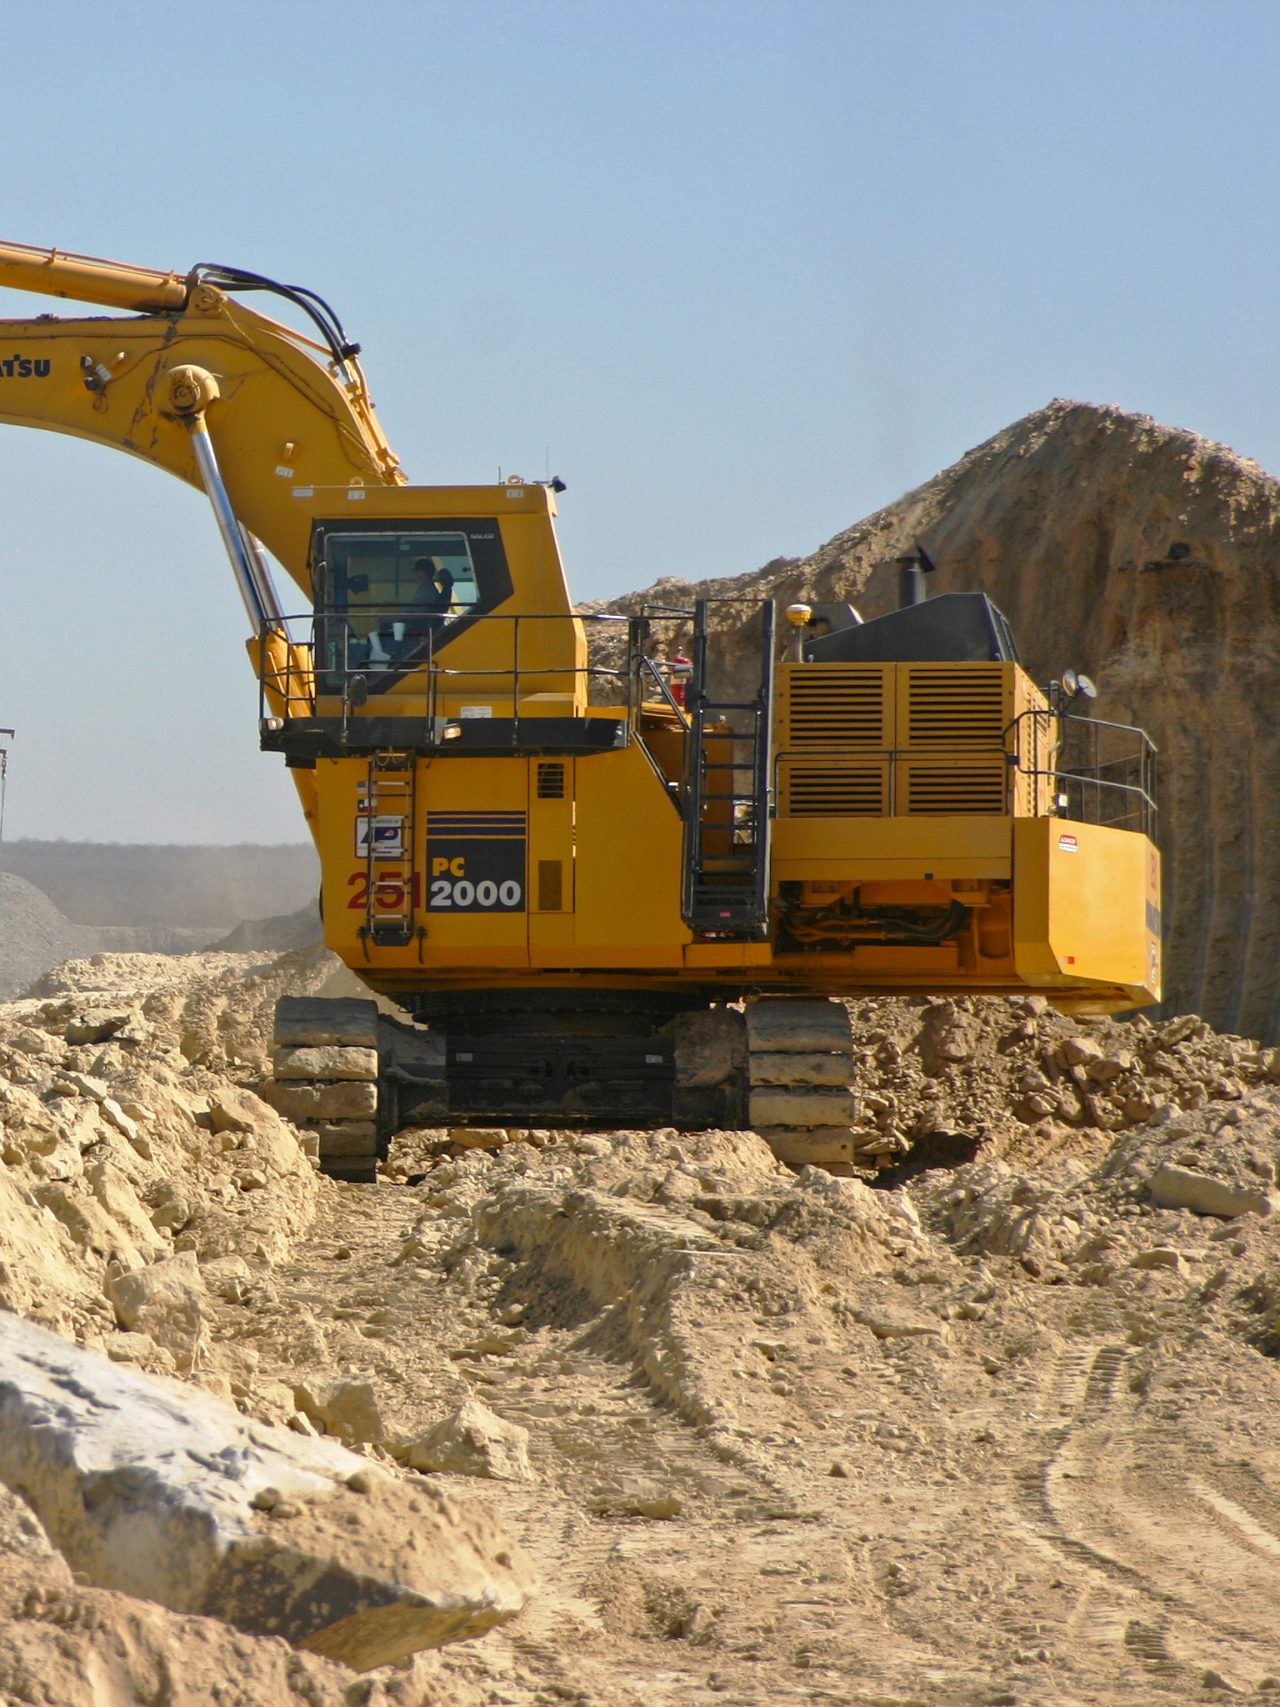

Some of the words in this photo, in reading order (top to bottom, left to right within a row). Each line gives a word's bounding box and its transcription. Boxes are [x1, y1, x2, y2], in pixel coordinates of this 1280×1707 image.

[432, 857, 465, 877] PC
[347, 872, 421, 909] 251
[430, 880, 521, 907] 2000
